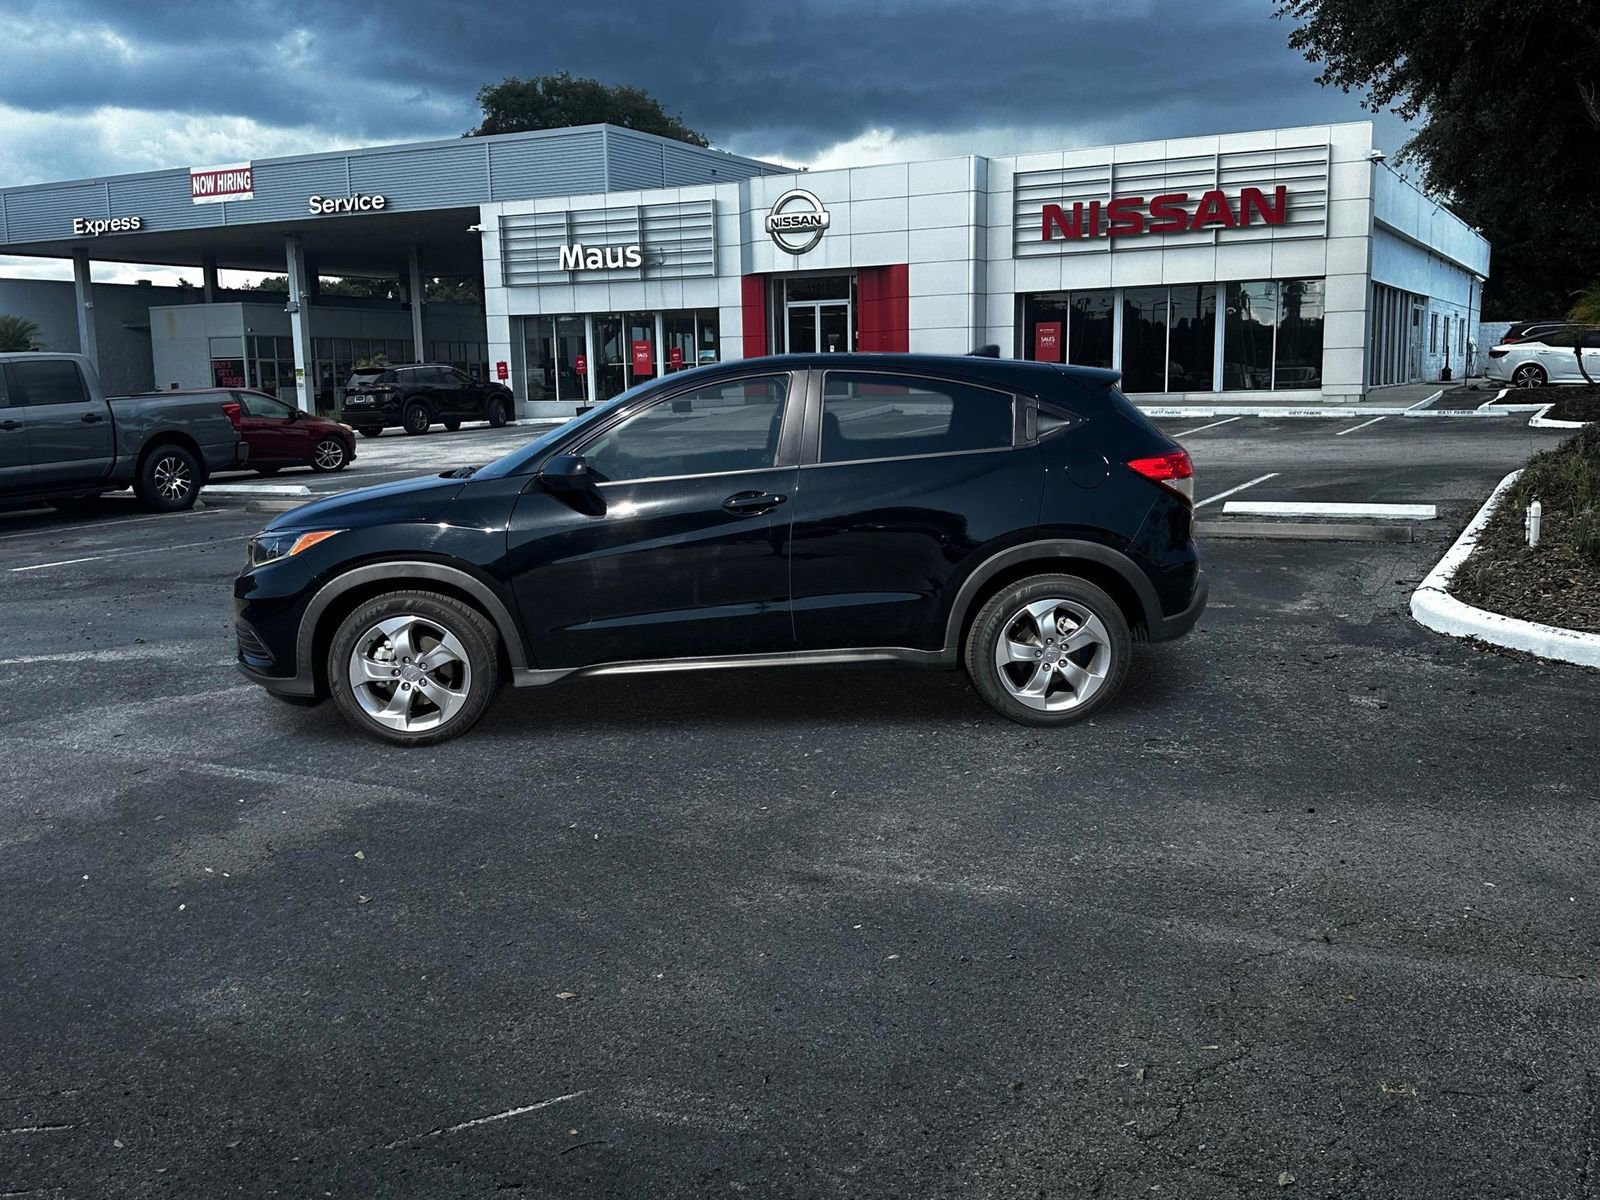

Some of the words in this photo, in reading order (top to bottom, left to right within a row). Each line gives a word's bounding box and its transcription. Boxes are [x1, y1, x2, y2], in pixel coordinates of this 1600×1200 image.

[193, 175, 215, 195] NOW
[217, 171, 251, 193] HIRING
[309, 193, 385, 215] Service
[1042, 185, 1286, 241] NISSAN
[73, 216, 141, 237] Express
[770, 214, 822, 228] NISSAN
[559, 243, 642, 271] Maus
[222, 377, 244, 387] FREE
